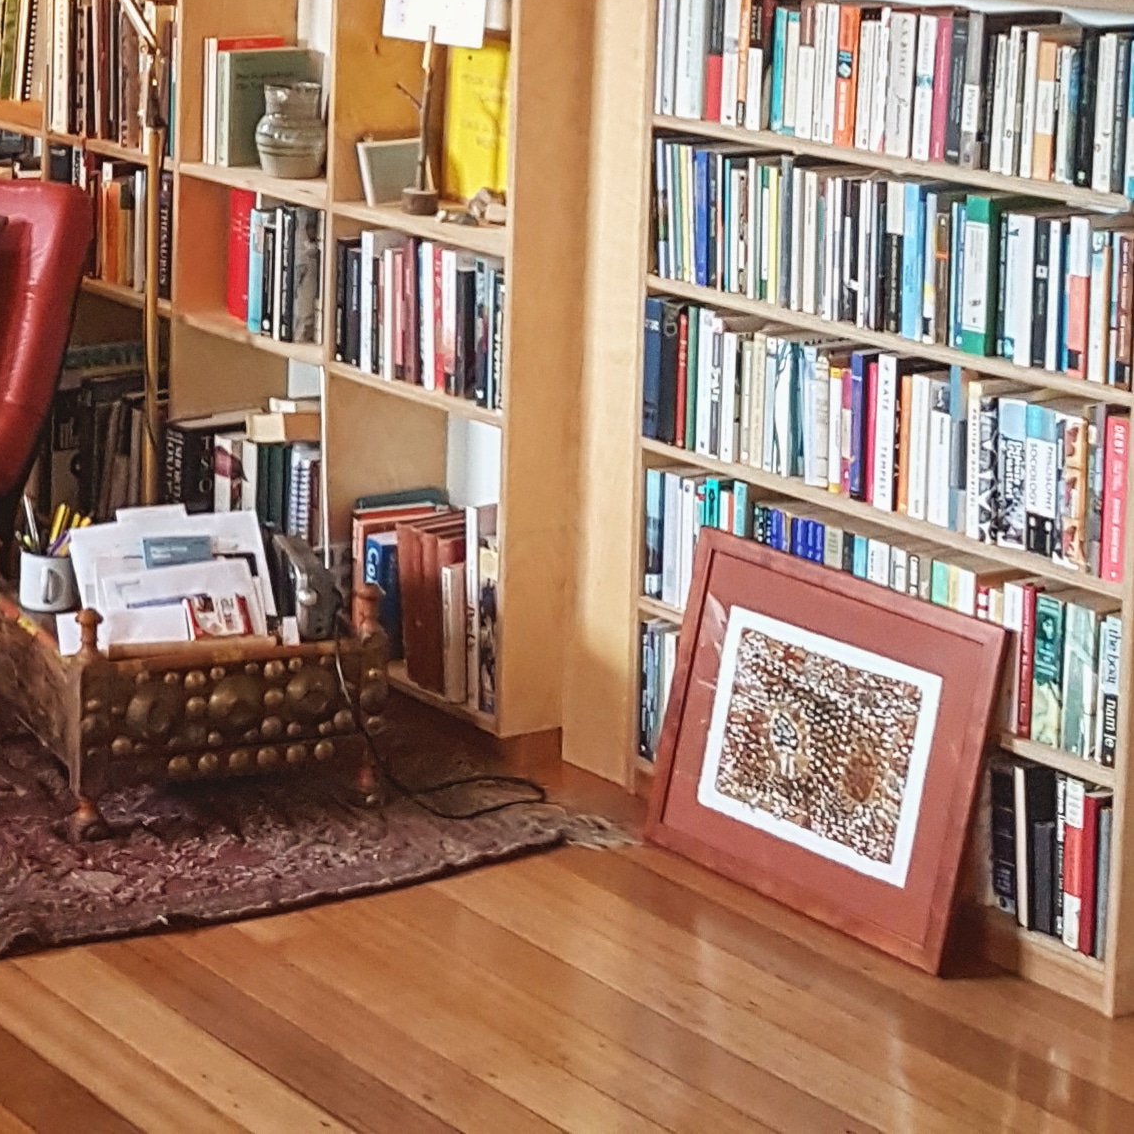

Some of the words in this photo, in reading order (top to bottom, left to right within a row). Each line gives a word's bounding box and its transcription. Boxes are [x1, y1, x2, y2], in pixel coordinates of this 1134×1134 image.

[159, 208, 169, 286] THESAURUS
[1114, 424, 1125, 455] DEBT
[879, 446, 889, 498] TEMPEST
[1028, 442, 1038, 507] SOCIOLOGY
[1044, 446, 1053, 511] PHILOSOPHY
[1107, 628, 1121, 651] the
[1105, 653, 1121, 685] boat
[1105, 699, 1117, 731] nam
